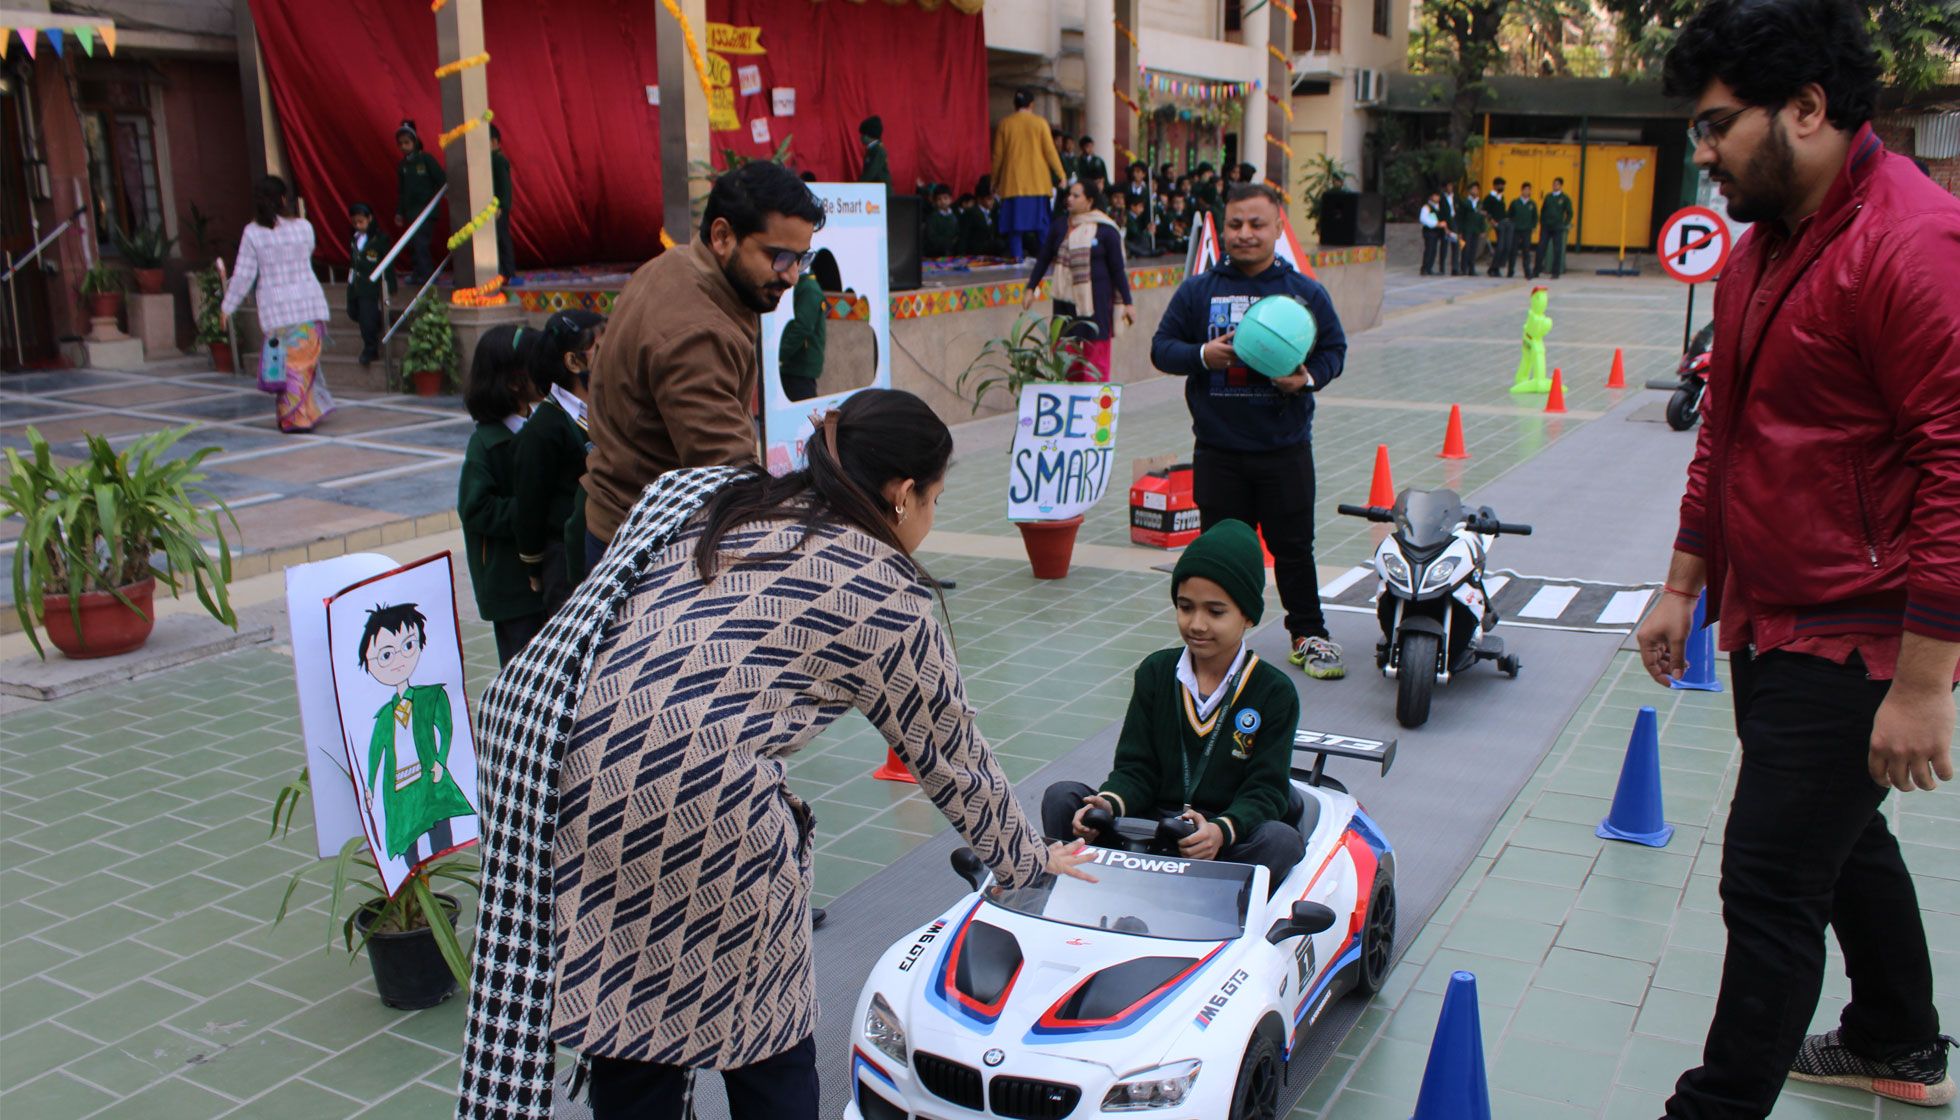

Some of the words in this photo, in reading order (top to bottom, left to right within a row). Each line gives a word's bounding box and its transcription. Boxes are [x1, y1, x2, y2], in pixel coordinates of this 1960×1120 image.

[836, 198, 862, 213] Smart
[1677, 224, 1711, 265] P
[1033, 393, 1091, 438] BE
[1010, 448, 1113, 504] SMART
[1105, 851, 1191, 874] Power
[919, 922, 944, 943] M6
[898, 944, 925, 972] GT3
[1200, 994, 1229, 1021] M6
[1220, 968, 1249, 996] GT3
